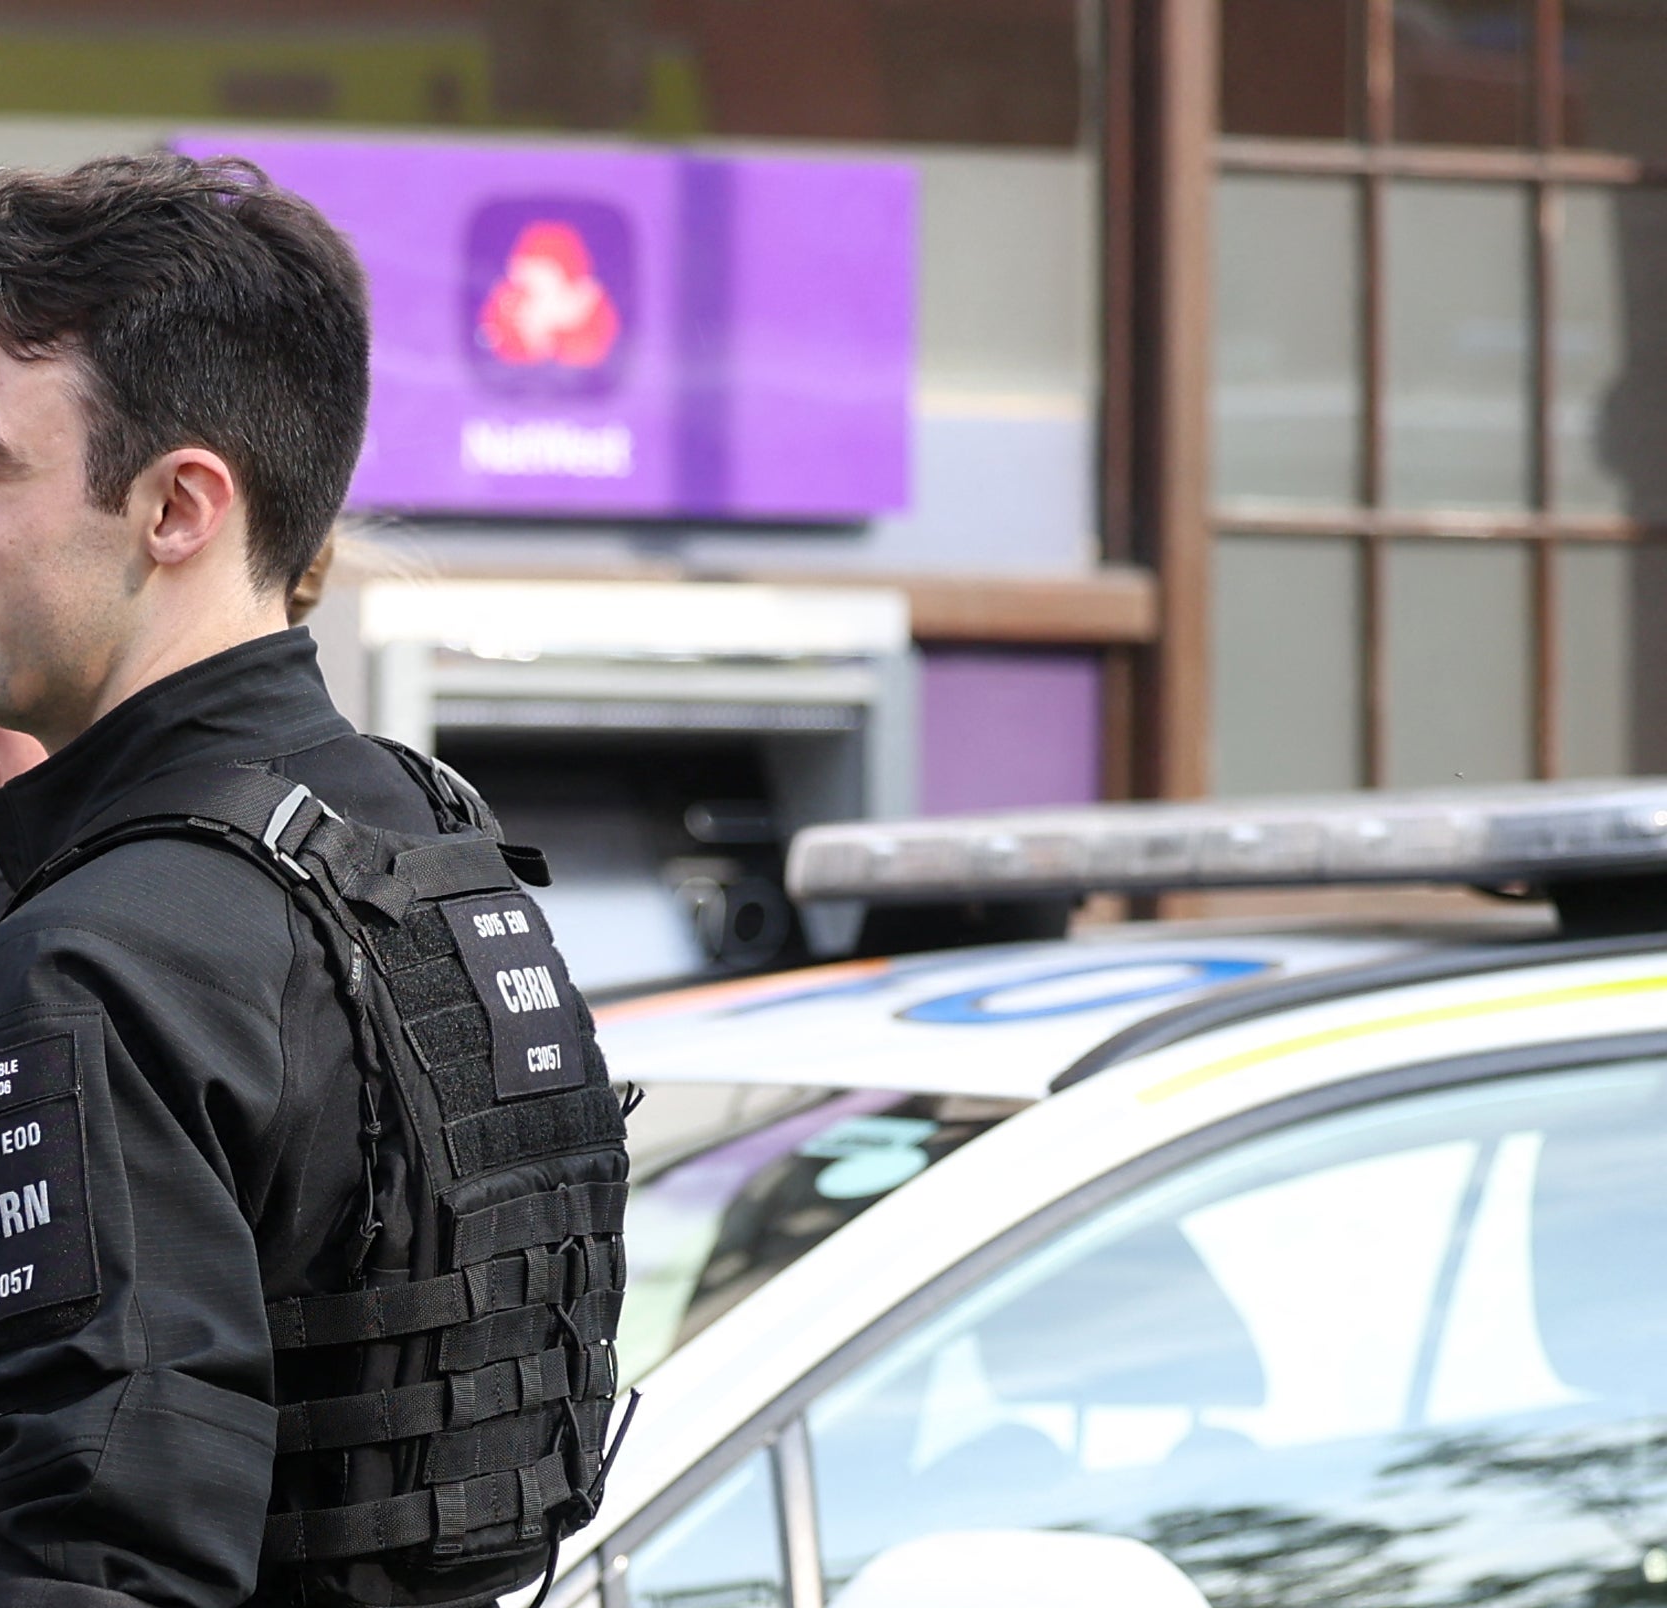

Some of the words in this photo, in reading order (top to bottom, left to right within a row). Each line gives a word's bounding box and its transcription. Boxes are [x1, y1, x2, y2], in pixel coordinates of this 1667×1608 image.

[473, 912, 506, 938] SO15
[496, 965, 561, 1013] CBRN
[527, 1043, 562, 1074] C3057
[1, 1121, 42, 1156] EOD
